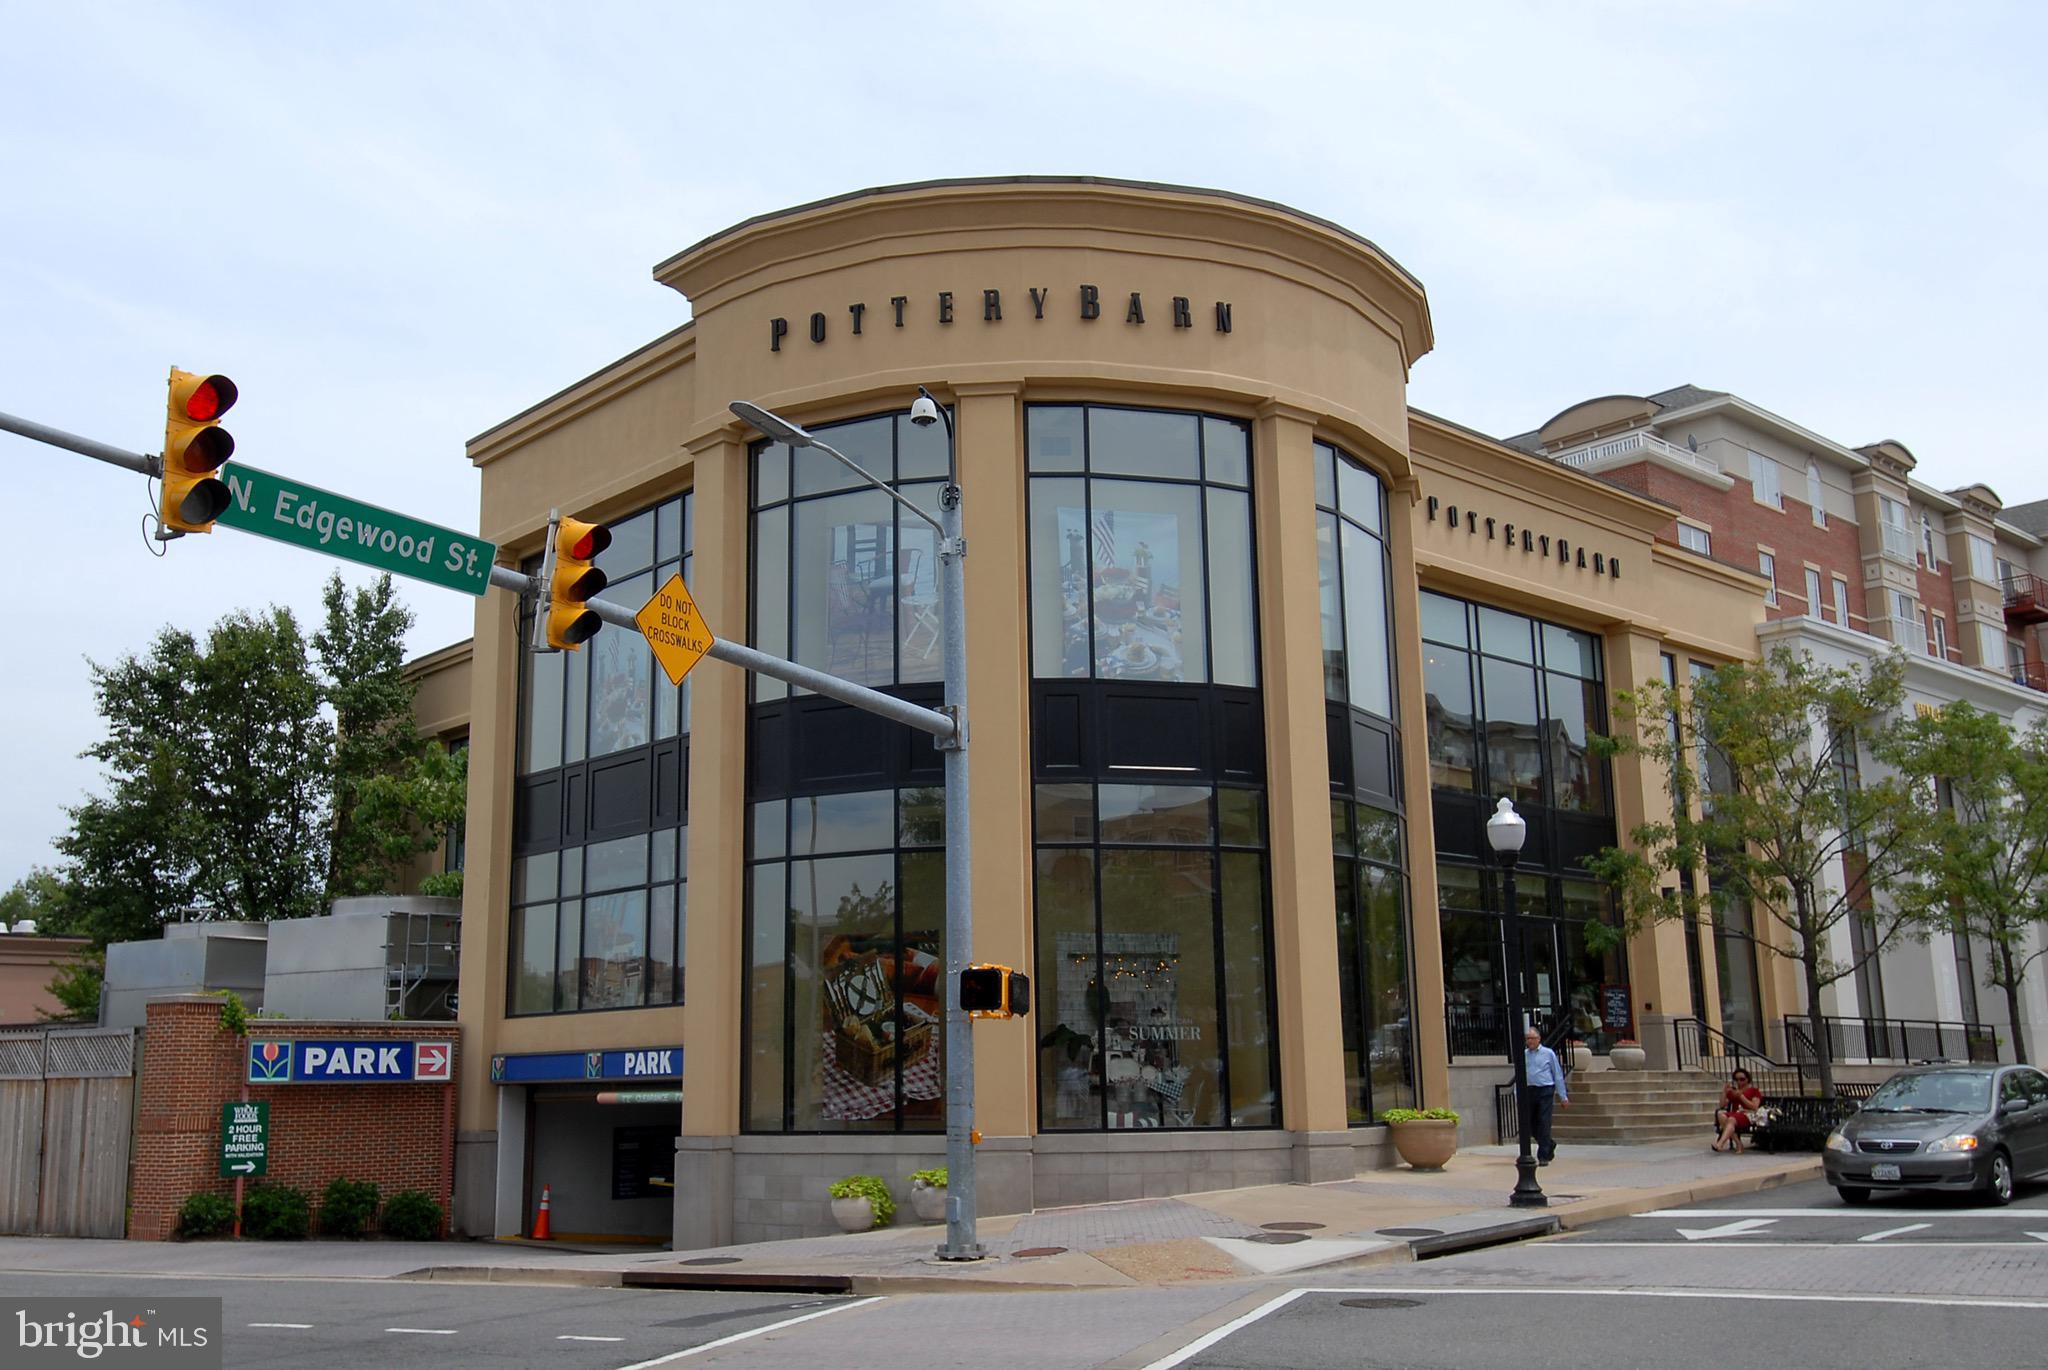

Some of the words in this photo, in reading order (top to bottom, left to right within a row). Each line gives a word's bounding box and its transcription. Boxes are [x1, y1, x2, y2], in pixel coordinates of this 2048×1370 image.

[228, 474, 256, 513] N.
[274, 489, 435, 564] Edgewood
[445, 542, 482, 578] St.
[660, 593, 672, 609] DO
[676, 598, 692, 616] NOT
[661, 612, 690, 632] BLOCK
[647, 625, 703, 654] CROSSWALKS
[1129, 1025, 1201, 1040] SUMMER
[304, 1047, 402, 1075] PARK
[624, 1050, 672, 1076] PARK
[228, 1125, 235, 1134] 2
[236, 1124, 262, 1133] HOUR
[232, 1134, 258, 1143] FREE
[225, 1142, 264, 1152] PARKING
